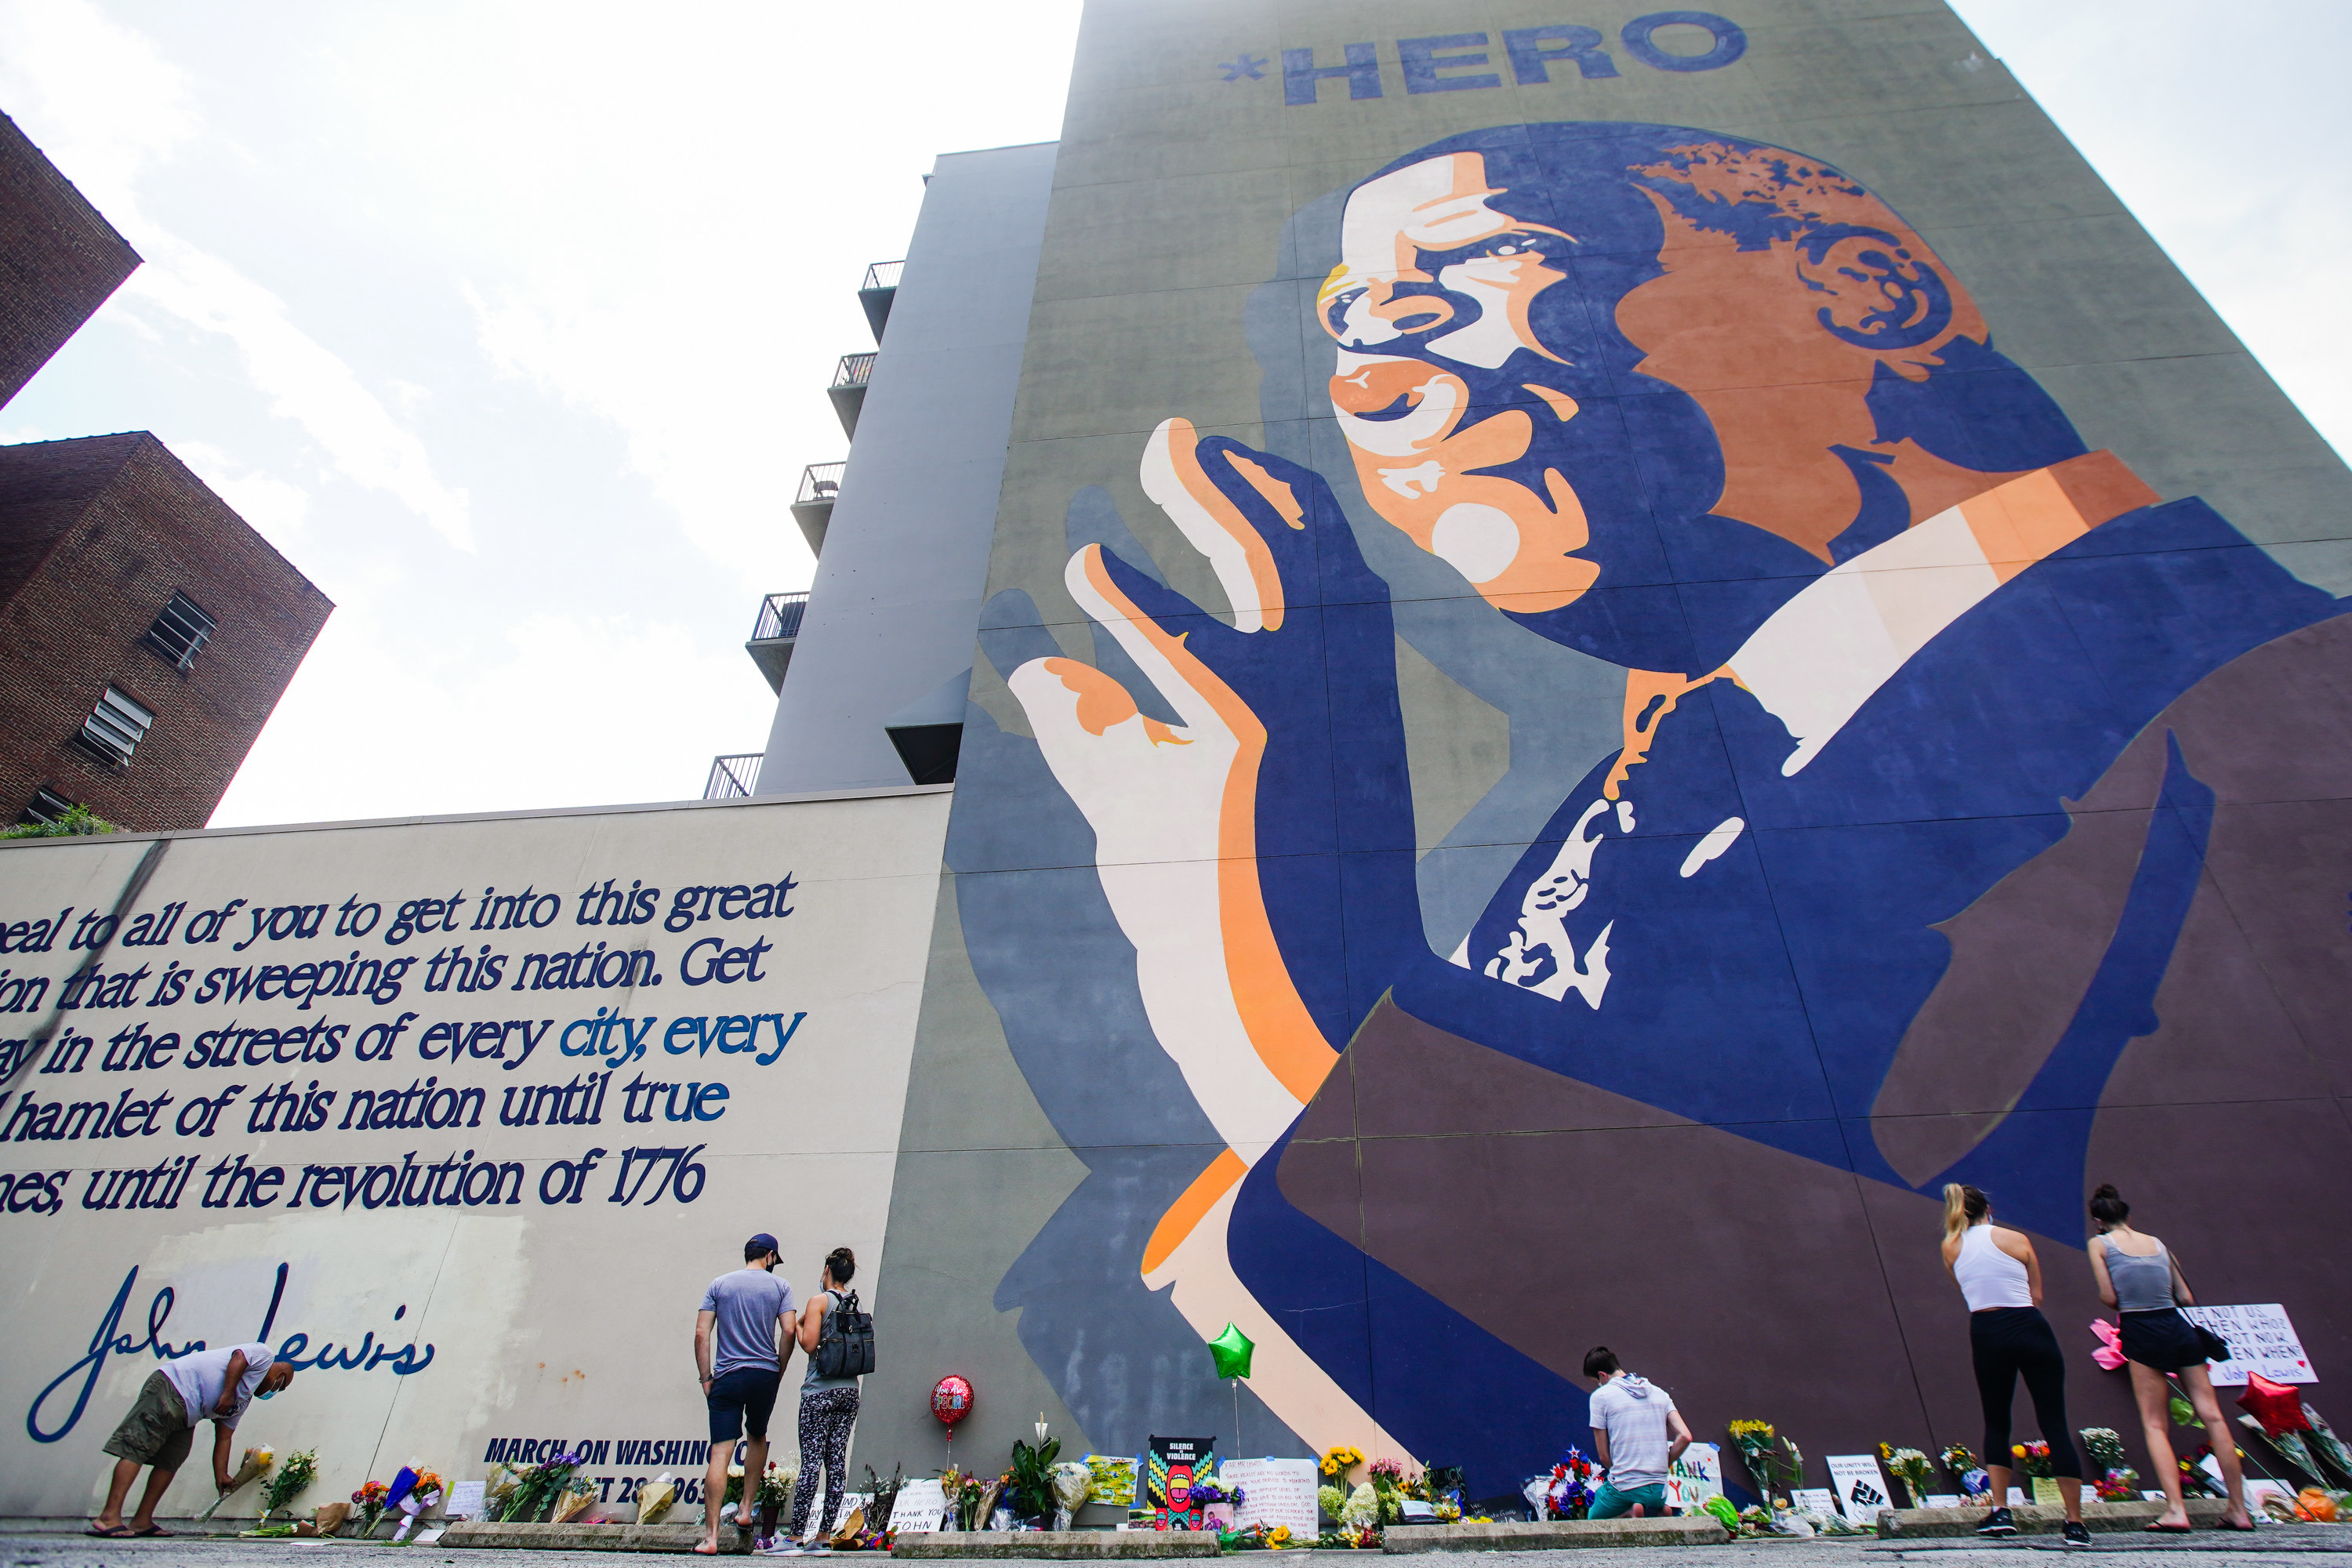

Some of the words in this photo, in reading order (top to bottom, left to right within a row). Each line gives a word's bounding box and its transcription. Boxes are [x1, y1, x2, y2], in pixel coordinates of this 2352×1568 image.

[0, 907, 74, 953] eal
[68, 909, 119, 950] to
[122, 902, 187, 946] all
[185, 899, 247, 943] of
[233, 905, 328, 951] you
[335, 894, 381, 937] to
[385, 891, 466, 945] get
[470, 887, 560, 930] into
[577, 879, 659, 924] this
[664, 872, 798, 932] great
[56, 963, 151, 1009] that
[146, 961, 194, 1006] is
[194, 951, 418, 1009] sweeping
[424, 945, 508, 992] this
[511, 942, 662, 990] nation.
[681, 936, 772, 985] Get
[39, 1027, 93, 1073] in
[101, 1022, 180, 1071] the
[183, 1015, 350, 1069] streets
[355, 1012, 419, 1061] of
[419, 1020, 554, 1070] every
[561, 1007, 657, 1069] city,
[664, 1013, 807, 1065] every
[0, 1088, 174, 1142] hamlet
[176, 1085, 247, 1137] of
[247, 1080, 337, 1133] this
[338, 1076, 485, 1130] nation
[499, 1071, 612, 1127] until
[622, 1072, 729, 1123] true
[82, 1155, 201, 1210] until
[201, 1154, 285, 1207] the
[287, 1150, 524, 1210] revolution
[539, 1149, 607, 1204] of
[608, 1145, 705, 1206] 1776
[2210, 1305, 2239, 1319] NOT
[27, 1264, 206, 1443] John
[2232, 1346, 2256, 1360] EN
[2222, 1365, 2249, 1381] Joh
[934, 1394, 964, 1410] SPECIAL
[484, 1438, 568, 1464] MARCH
[576, 1439, 610, 1465] ON
[1669, 1458, 1710, 1482] ANK
[1669, 1480, 1698, 1502] YOU
[893, 1510, 924, 1519] THANK
[893, 1521, 933, 1530] JOHN
